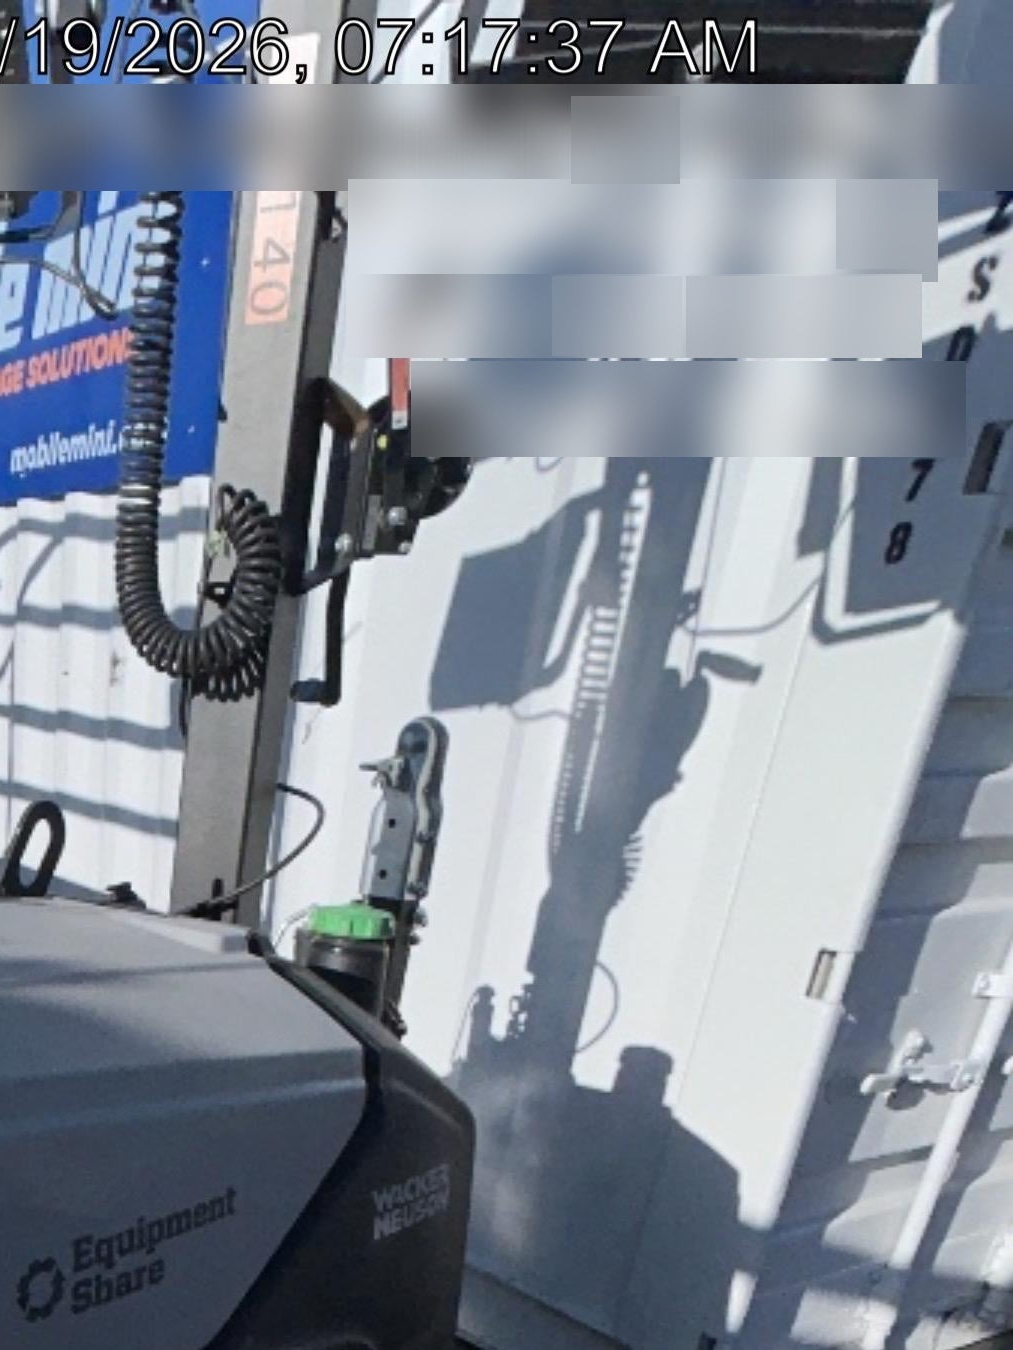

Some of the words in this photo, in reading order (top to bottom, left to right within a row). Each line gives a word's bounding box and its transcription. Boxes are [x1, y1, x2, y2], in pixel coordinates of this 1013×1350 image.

[372, 1163, 450, 1212] WACKER
[373, 1188, 450, 1241] NEUSON
[71, 1186, 238, 1273] Equipment
[70, 1257, 166, 1315] Share
